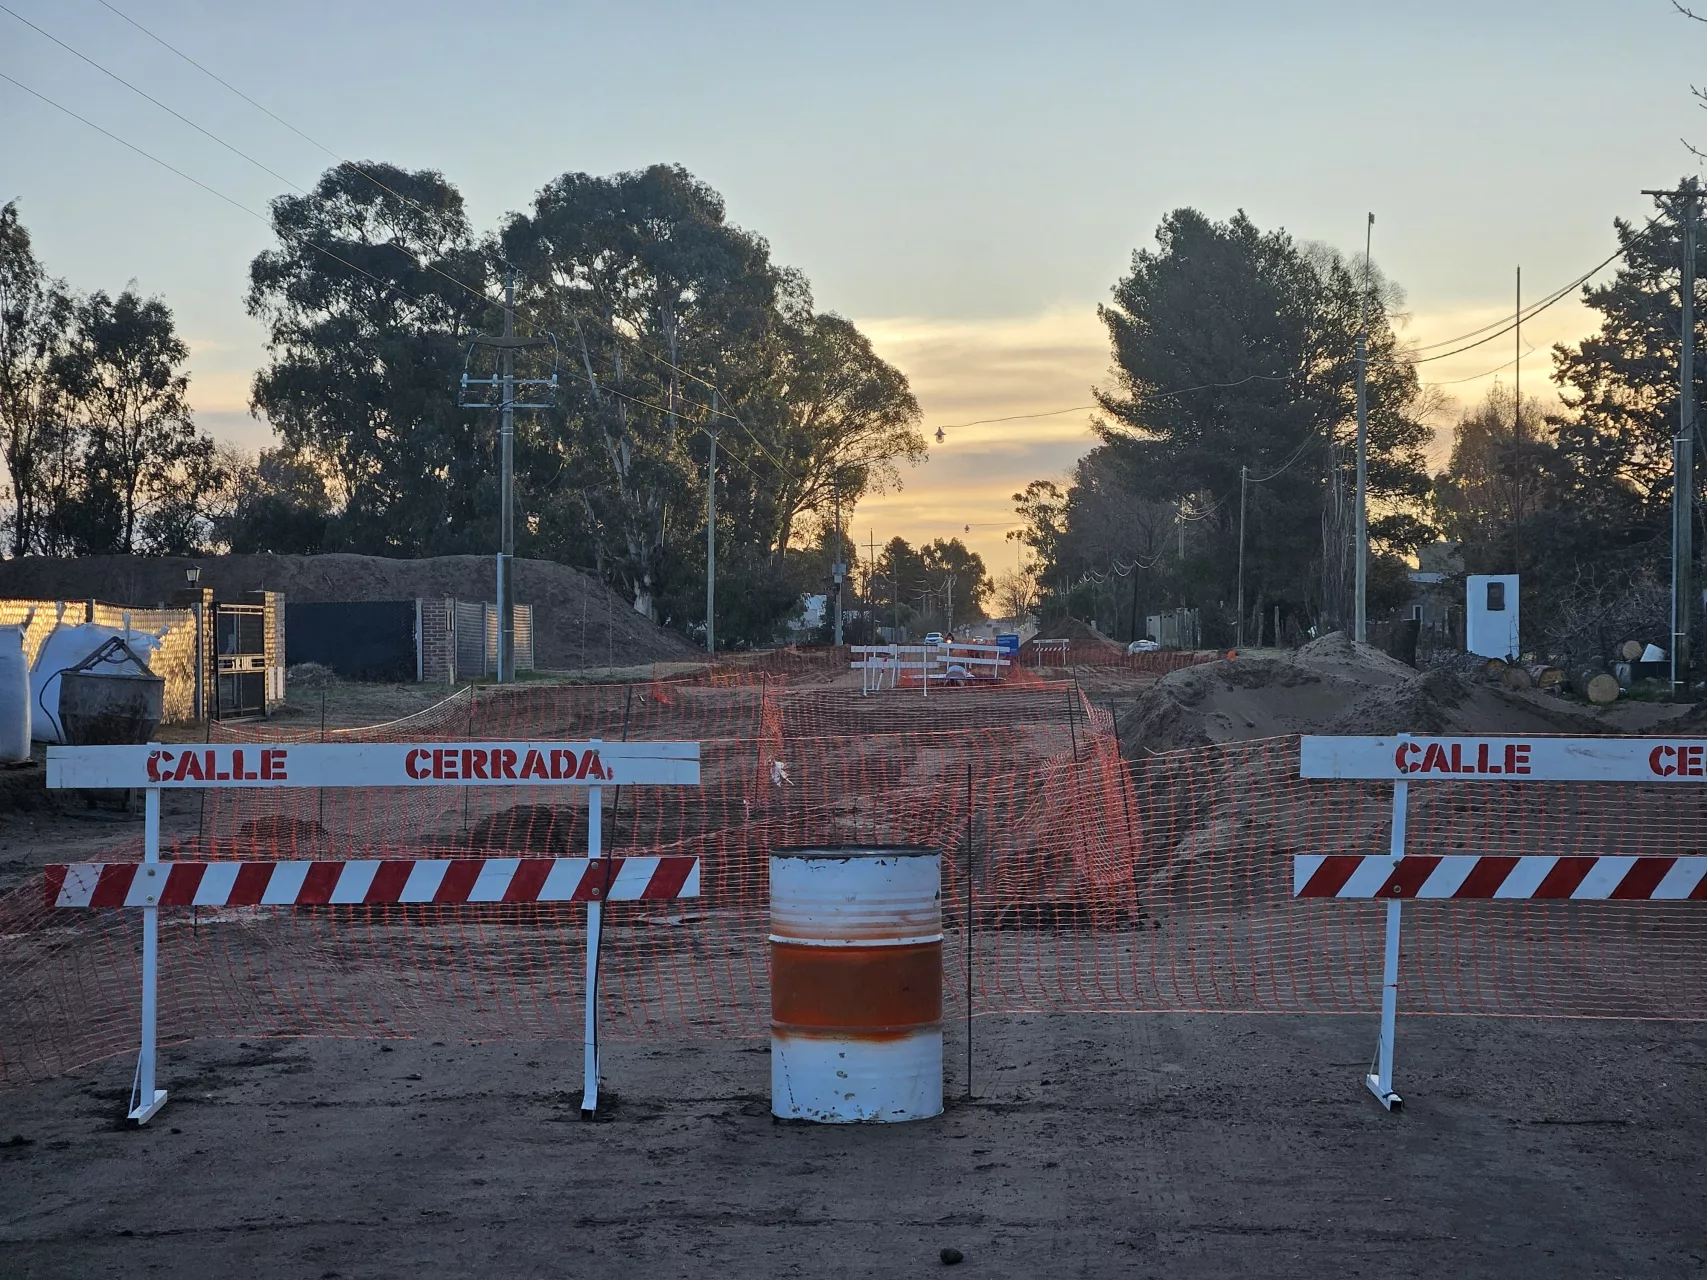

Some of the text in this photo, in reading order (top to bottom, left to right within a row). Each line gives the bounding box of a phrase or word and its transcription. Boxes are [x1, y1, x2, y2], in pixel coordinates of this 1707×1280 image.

[147, 749, 606, 782] CALLE CERRADA
[1396, 744, 1707, 777] CALLE CE
